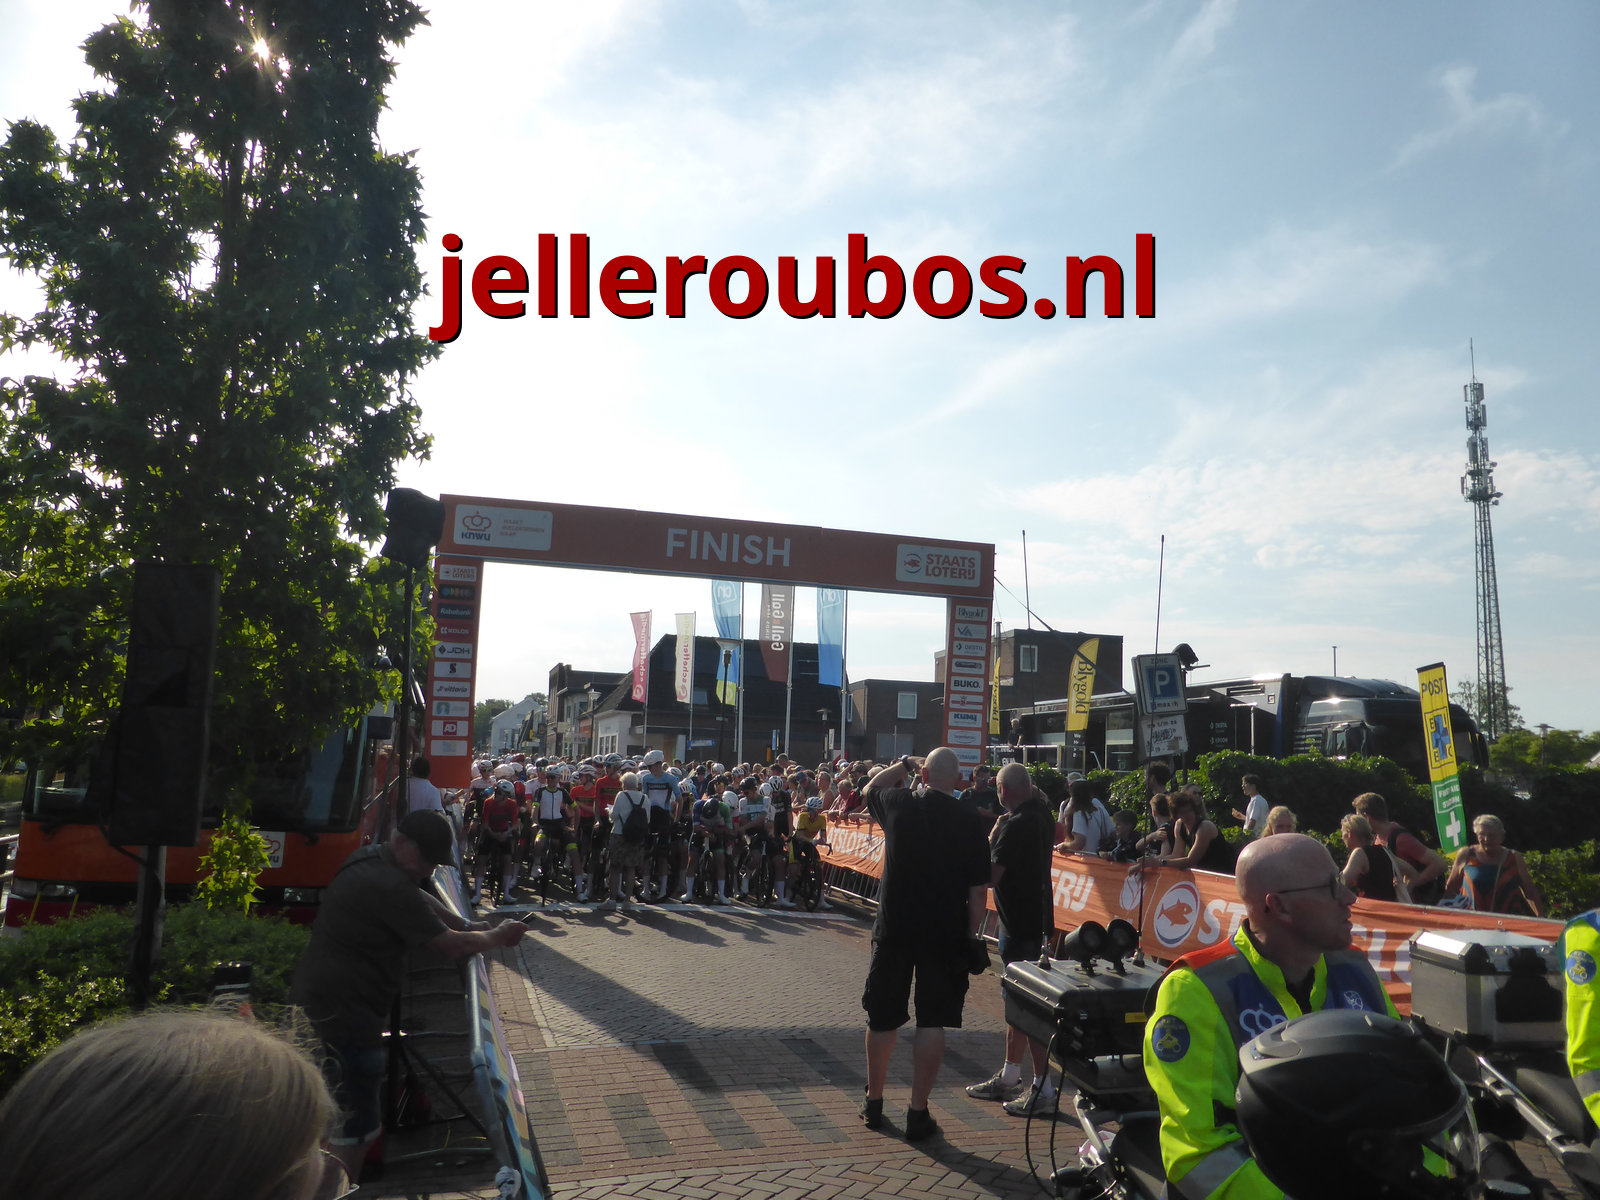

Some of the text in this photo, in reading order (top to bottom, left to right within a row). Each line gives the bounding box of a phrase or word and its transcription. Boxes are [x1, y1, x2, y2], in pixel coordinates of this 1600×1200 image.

[461, 531, 491, 541] KNWU
[666, 527, 791, 567] FINISH
[926, 553, 976, 568] STAATS
[925, 565, 976, 580] LOTERIJ
[1073, 661, 1094, 714] Blygold
[1156, 670, 1170, 695] P
[1421, 677, 1443, 698] POST
[444, 723, 457, 733] AD
